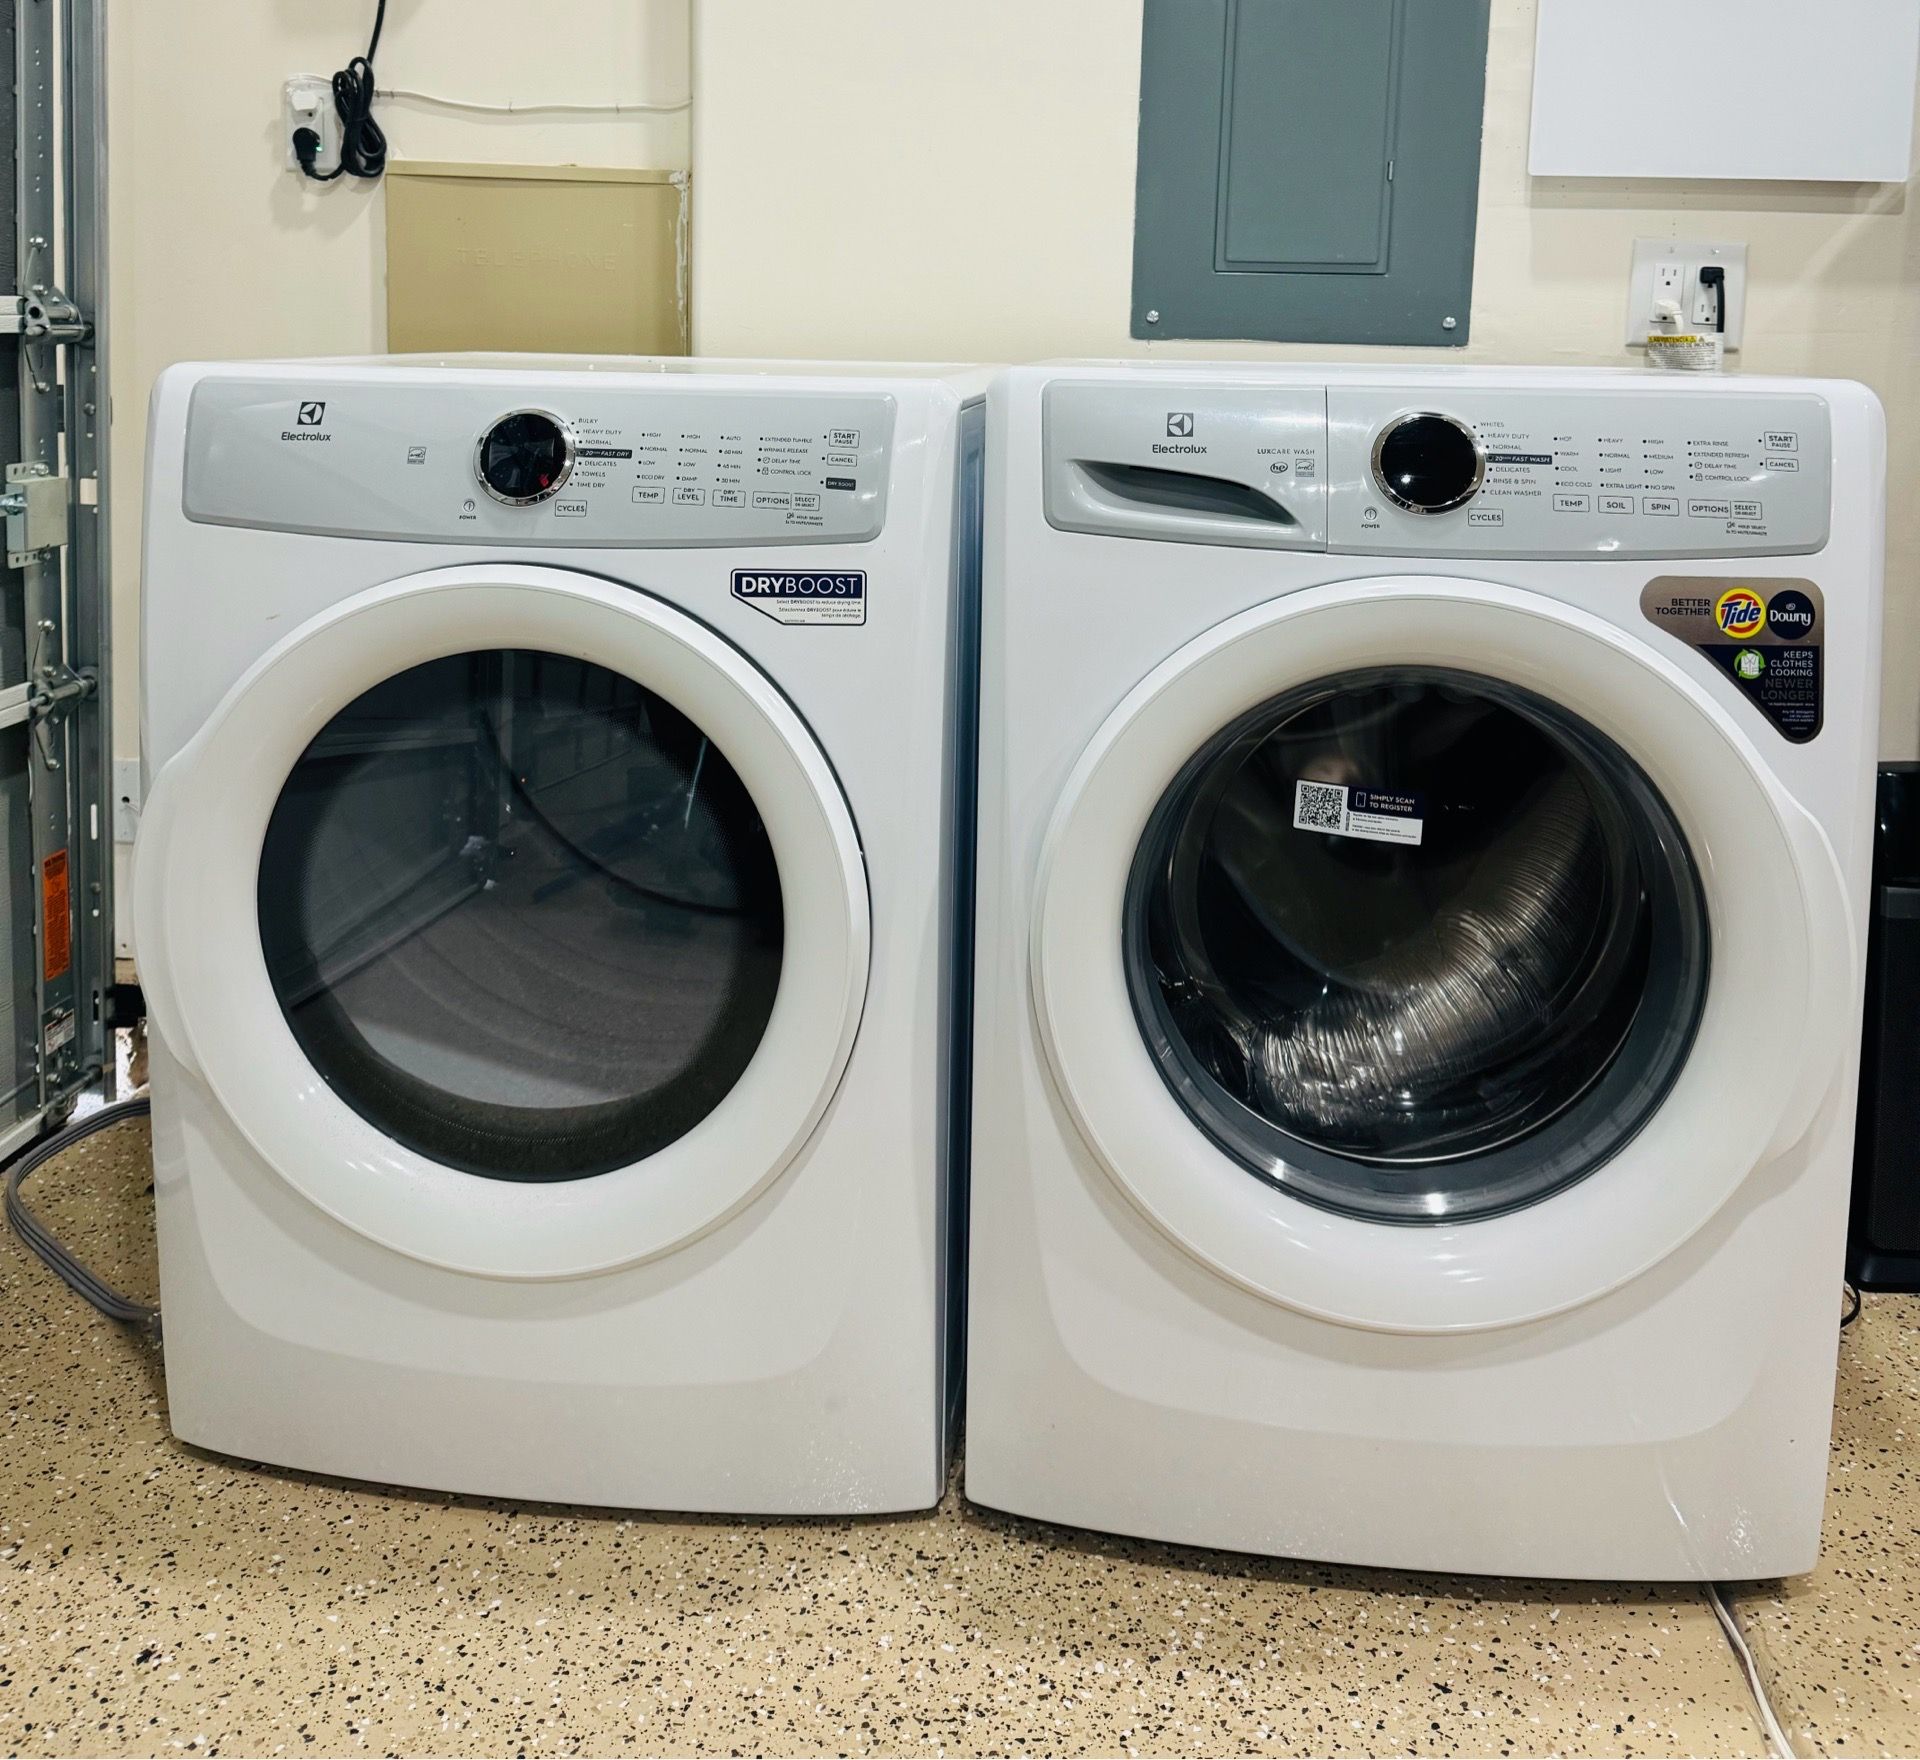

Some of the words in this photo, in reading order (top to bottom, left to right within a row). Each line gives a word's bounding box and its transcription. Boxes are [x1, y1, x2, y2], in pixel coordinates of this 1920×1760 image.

[281, 432, 331, 442] Electrolux
[1152, 444, 1207, 454] Electrolux
[638, 491, 659, 499] TEMP
[720, 495, 738, 503] TIME
[756, 497, 789, 505] OPTIONS
[1651, 503, 1671, 511] SPIN
[1691, 505, 1729, 513] OPTIONS
[741, 577, 858, 595] DRYBOOST
[1672, 599, 1711, 607] BETTER
[1656, 607, 1711, 616] TOGETHER
[1720, 600, 1762, 630] Tide
[1770, 610, 1811, 626] Downy
[1783, 651, 1813, 659] KEEPS
[1771, 660, 1813, 668] CLOTHES
[1770, 669, 1813, 677] LOOKING
[1765, 679, 1814, 689] NEWER
[1370, 794, 1394, 802] SIMPLY
[1395, 797, 1415, 805] SCAN
[1380, 803, 1413, 813] REGISTER
